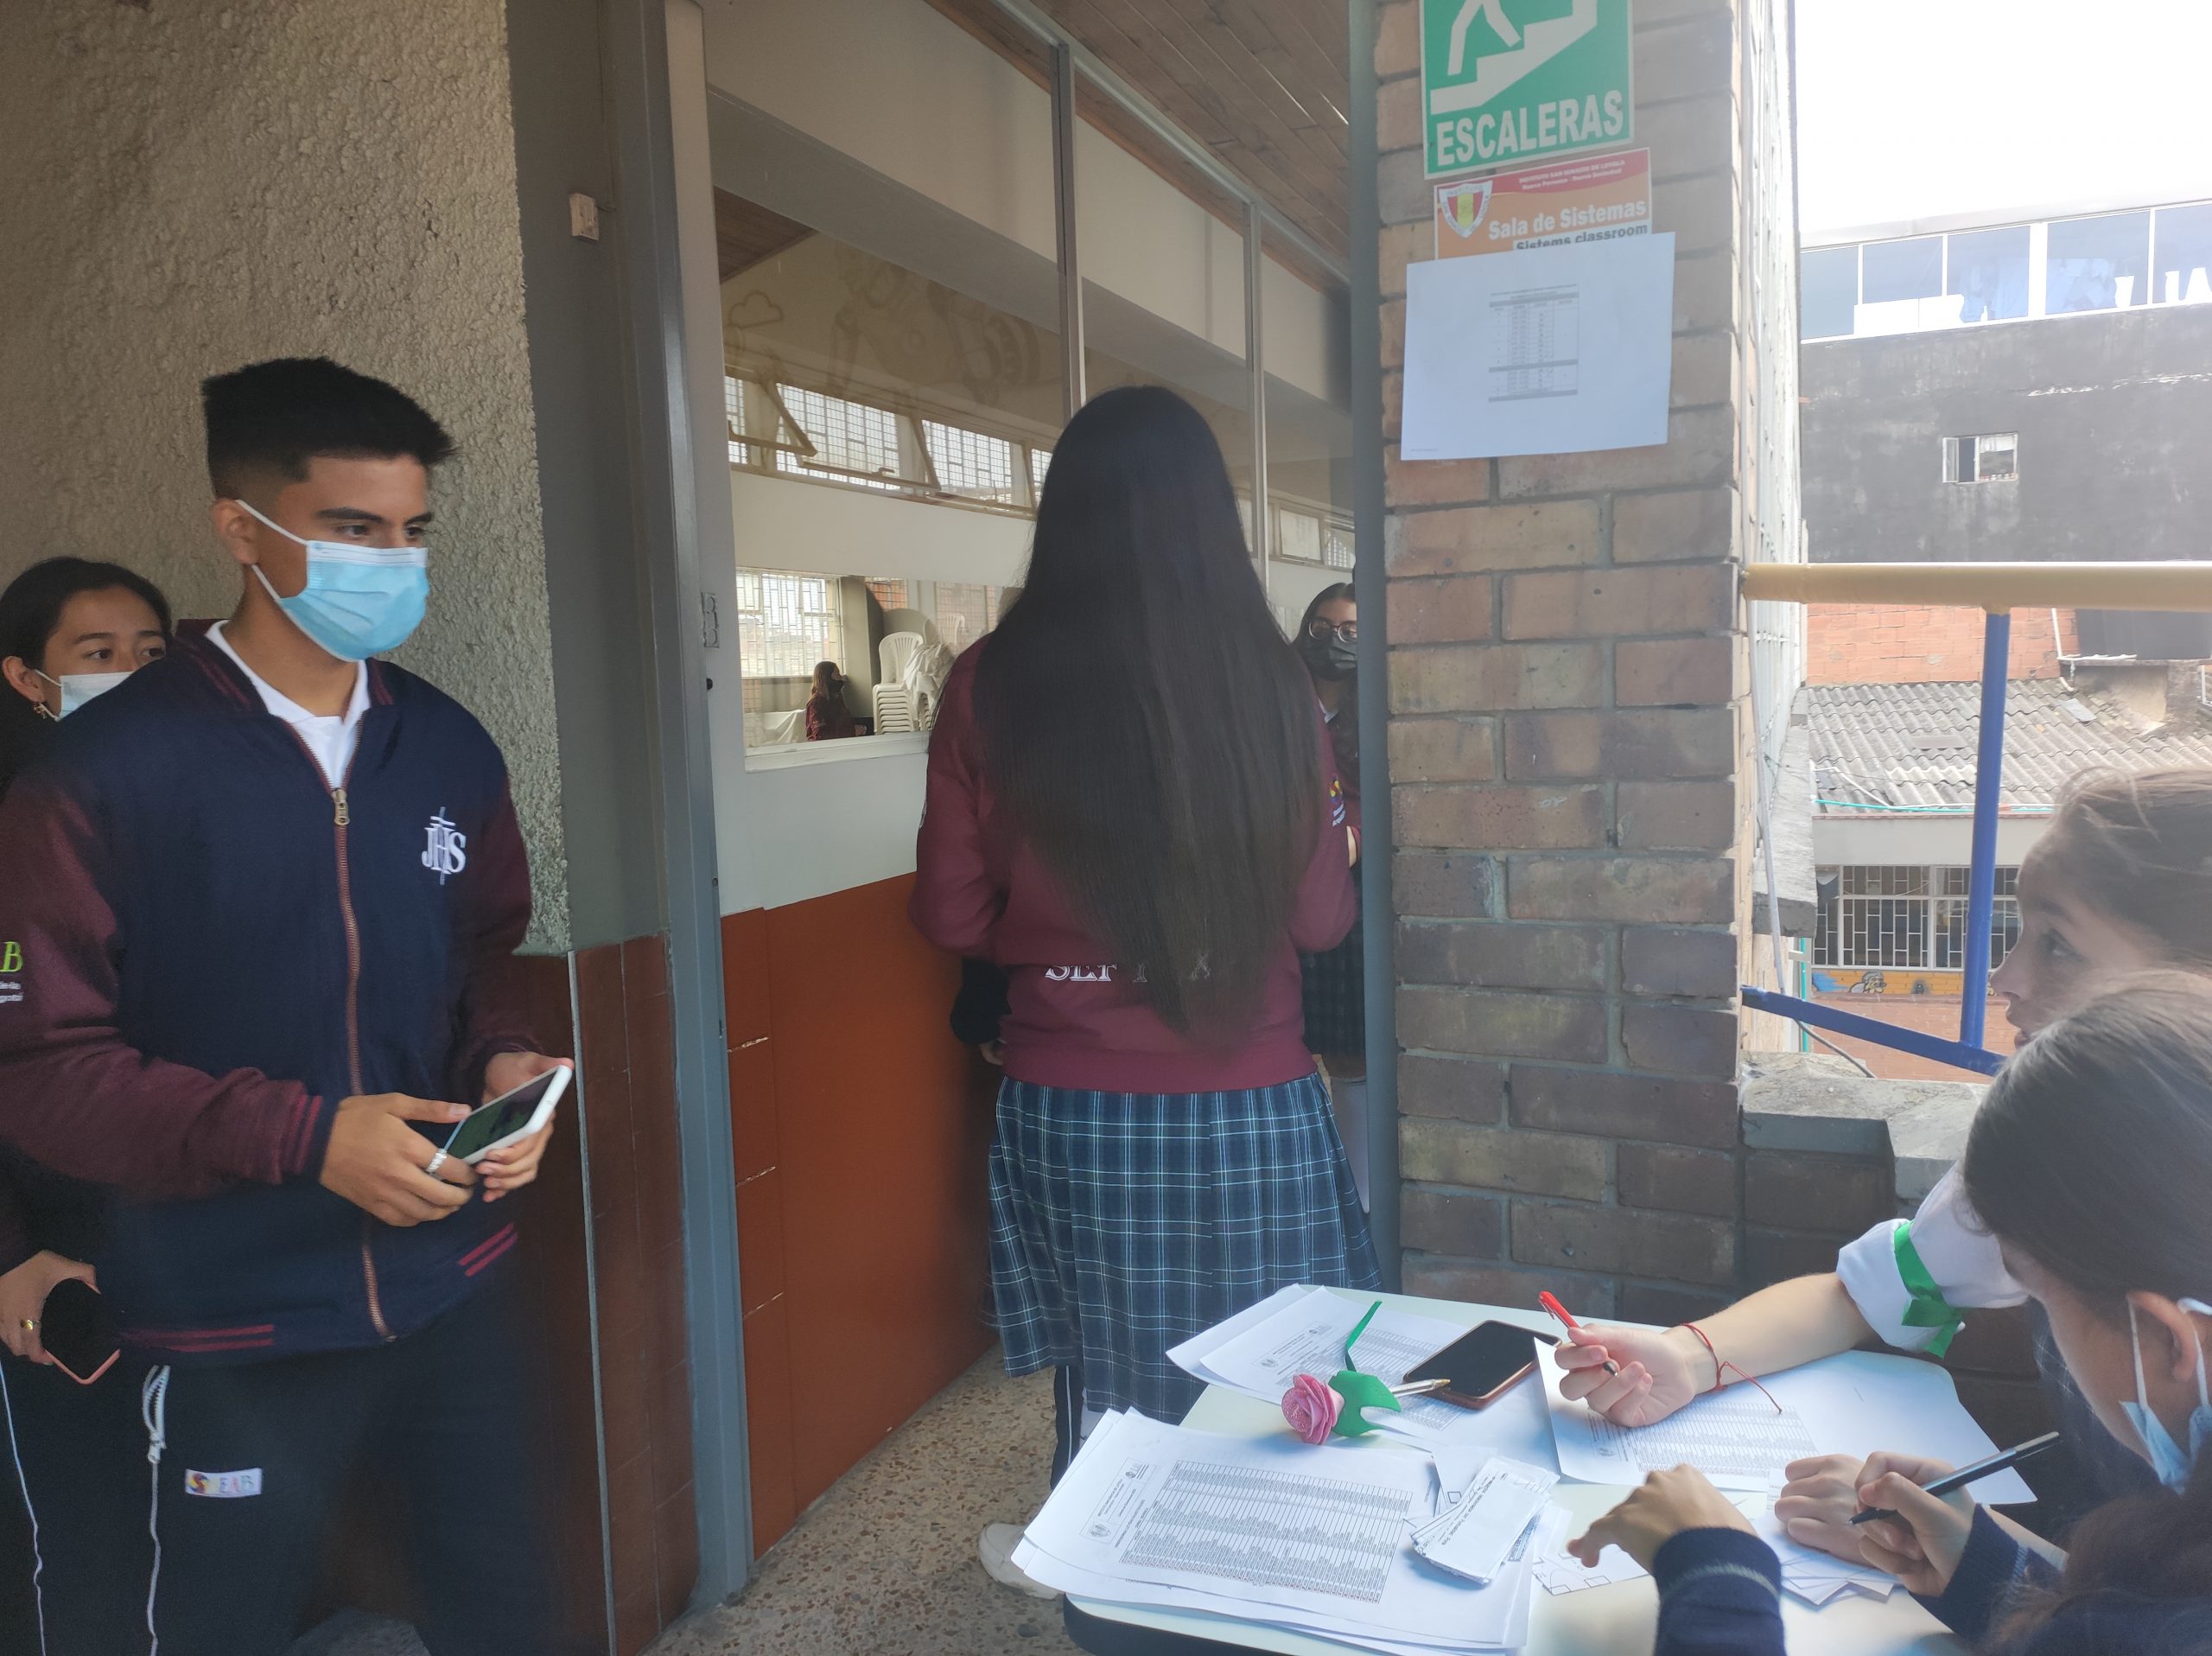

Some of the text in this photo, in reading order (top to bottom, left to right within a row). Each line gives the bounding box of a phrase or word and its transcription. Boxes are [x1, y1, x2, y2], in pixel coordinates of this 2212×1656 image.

[1436, 90, 1624, 167] ESCALERAS
[1488, 200, 1647, 240] Sala de Sistemas
[1575, 225, 1649, 244] classroom
